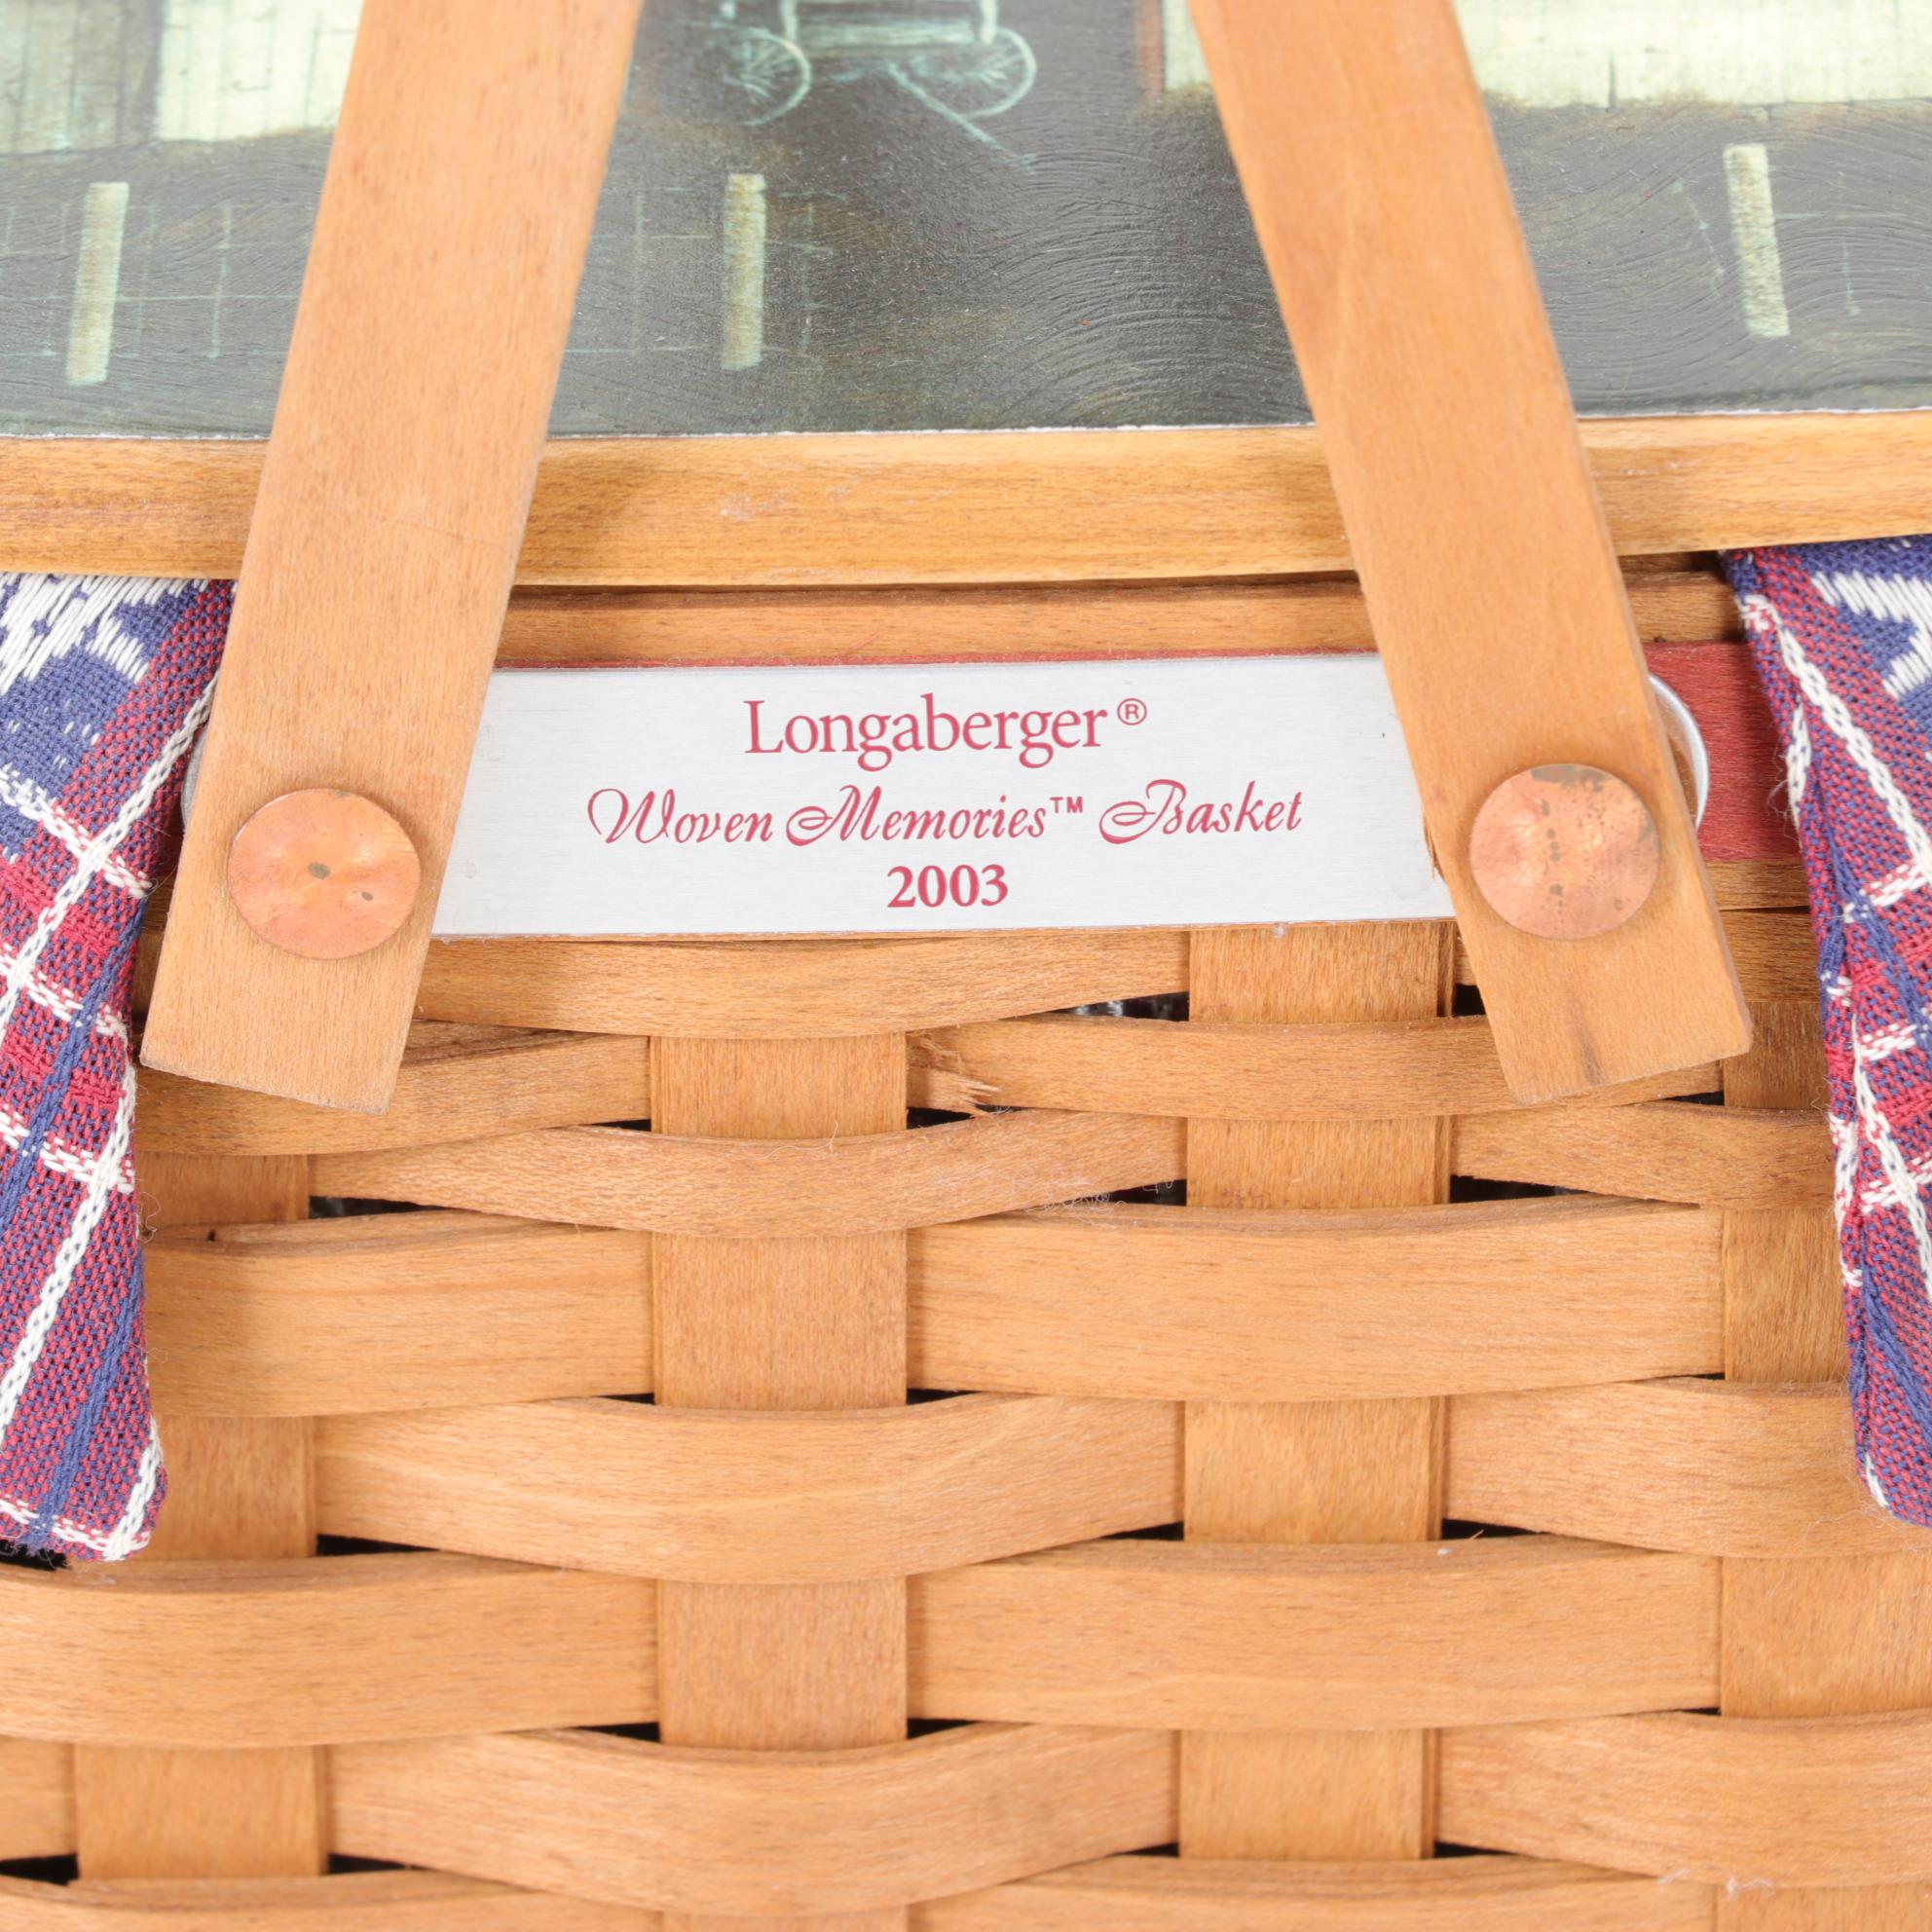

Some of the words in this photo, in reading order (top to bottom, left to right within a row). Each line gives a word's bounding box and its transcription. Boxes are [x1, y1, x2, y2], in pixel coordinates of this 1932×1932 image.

[587, 787, 774, 844] Woven
[1098, 778, 1303, 845] Basket
[887, 863, 1010, 909] 2003
